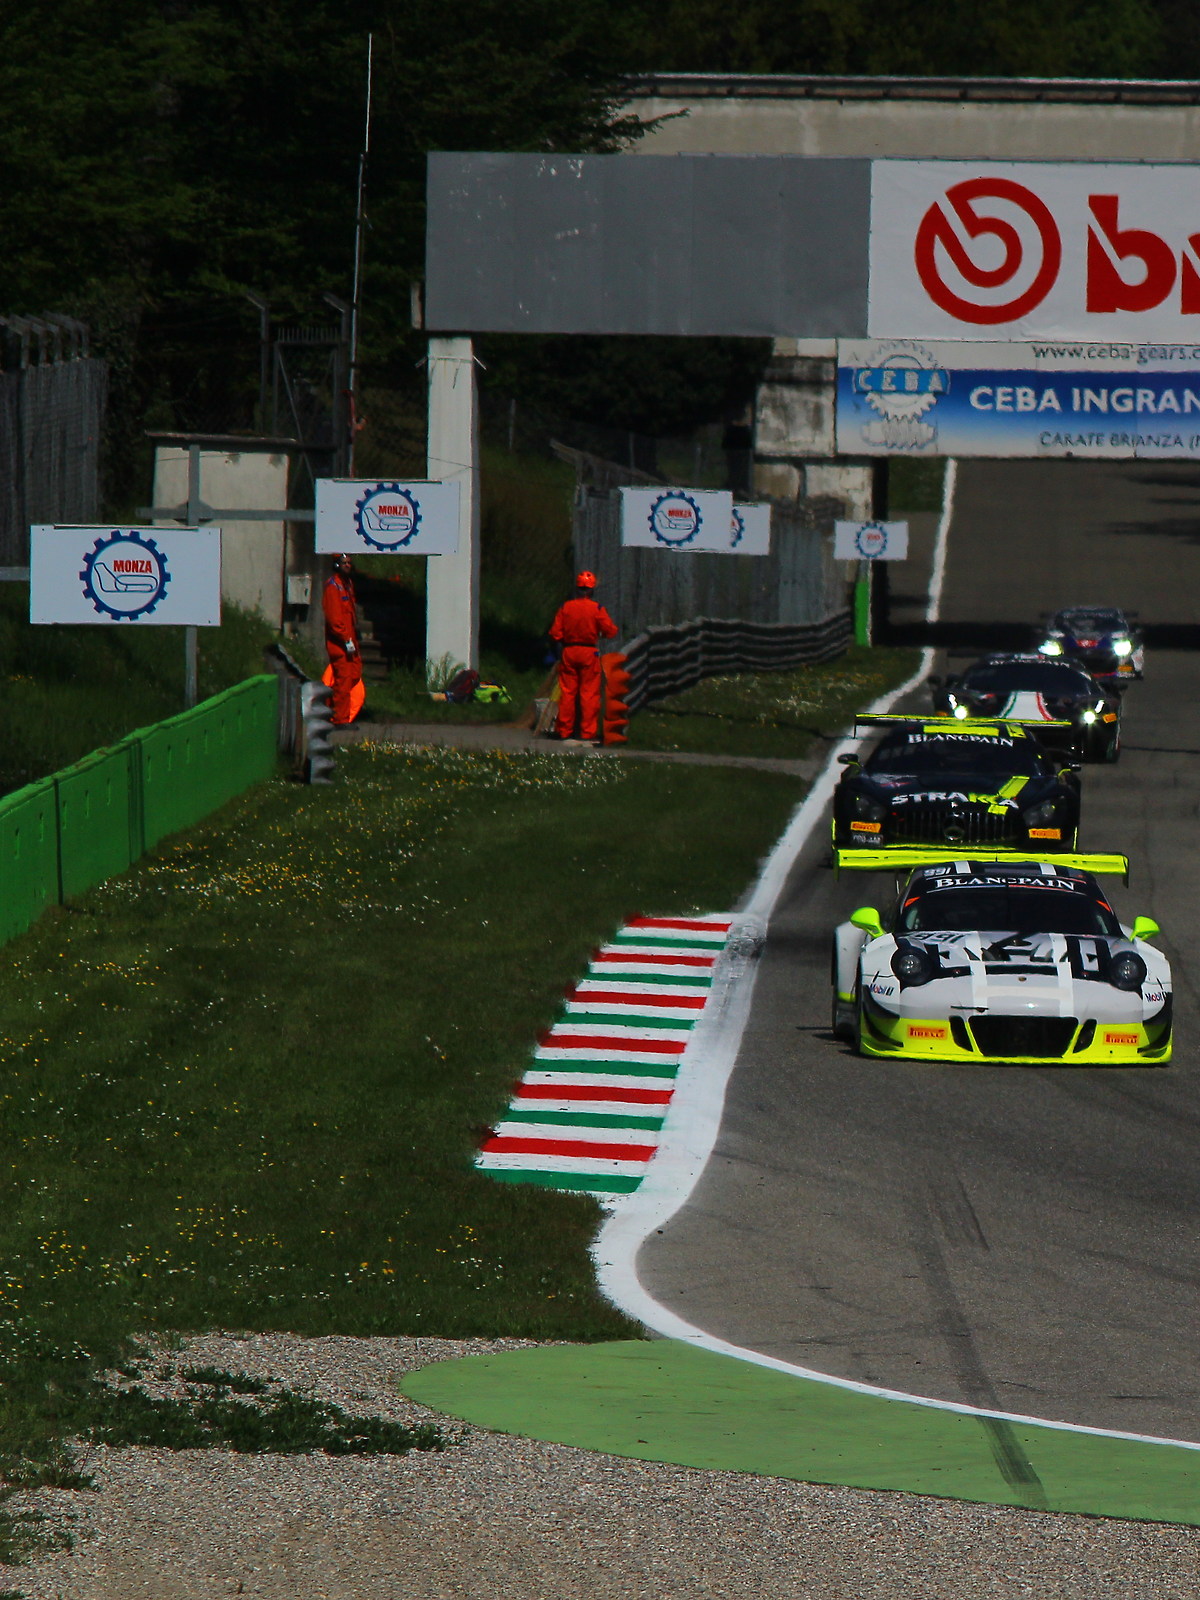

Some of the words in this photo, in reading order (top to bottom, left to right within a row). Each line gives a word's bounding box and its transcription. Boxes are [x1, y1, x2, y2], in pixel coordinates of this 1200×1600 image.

[858, 370, 943, 392] CEBA
[969, 386, 1062, 413] CEBA
[1039, 431, 1105, 449] CARATE
[1111, 433, 1183, 449] BRIANZA
[377, 504, 410, 517] MONZA
[113, 559, 153, 575] MONZA
[908, 733, 1014, 747] BLANCPAIN
[935, 877, 1075, 891] BLANCPAIN
